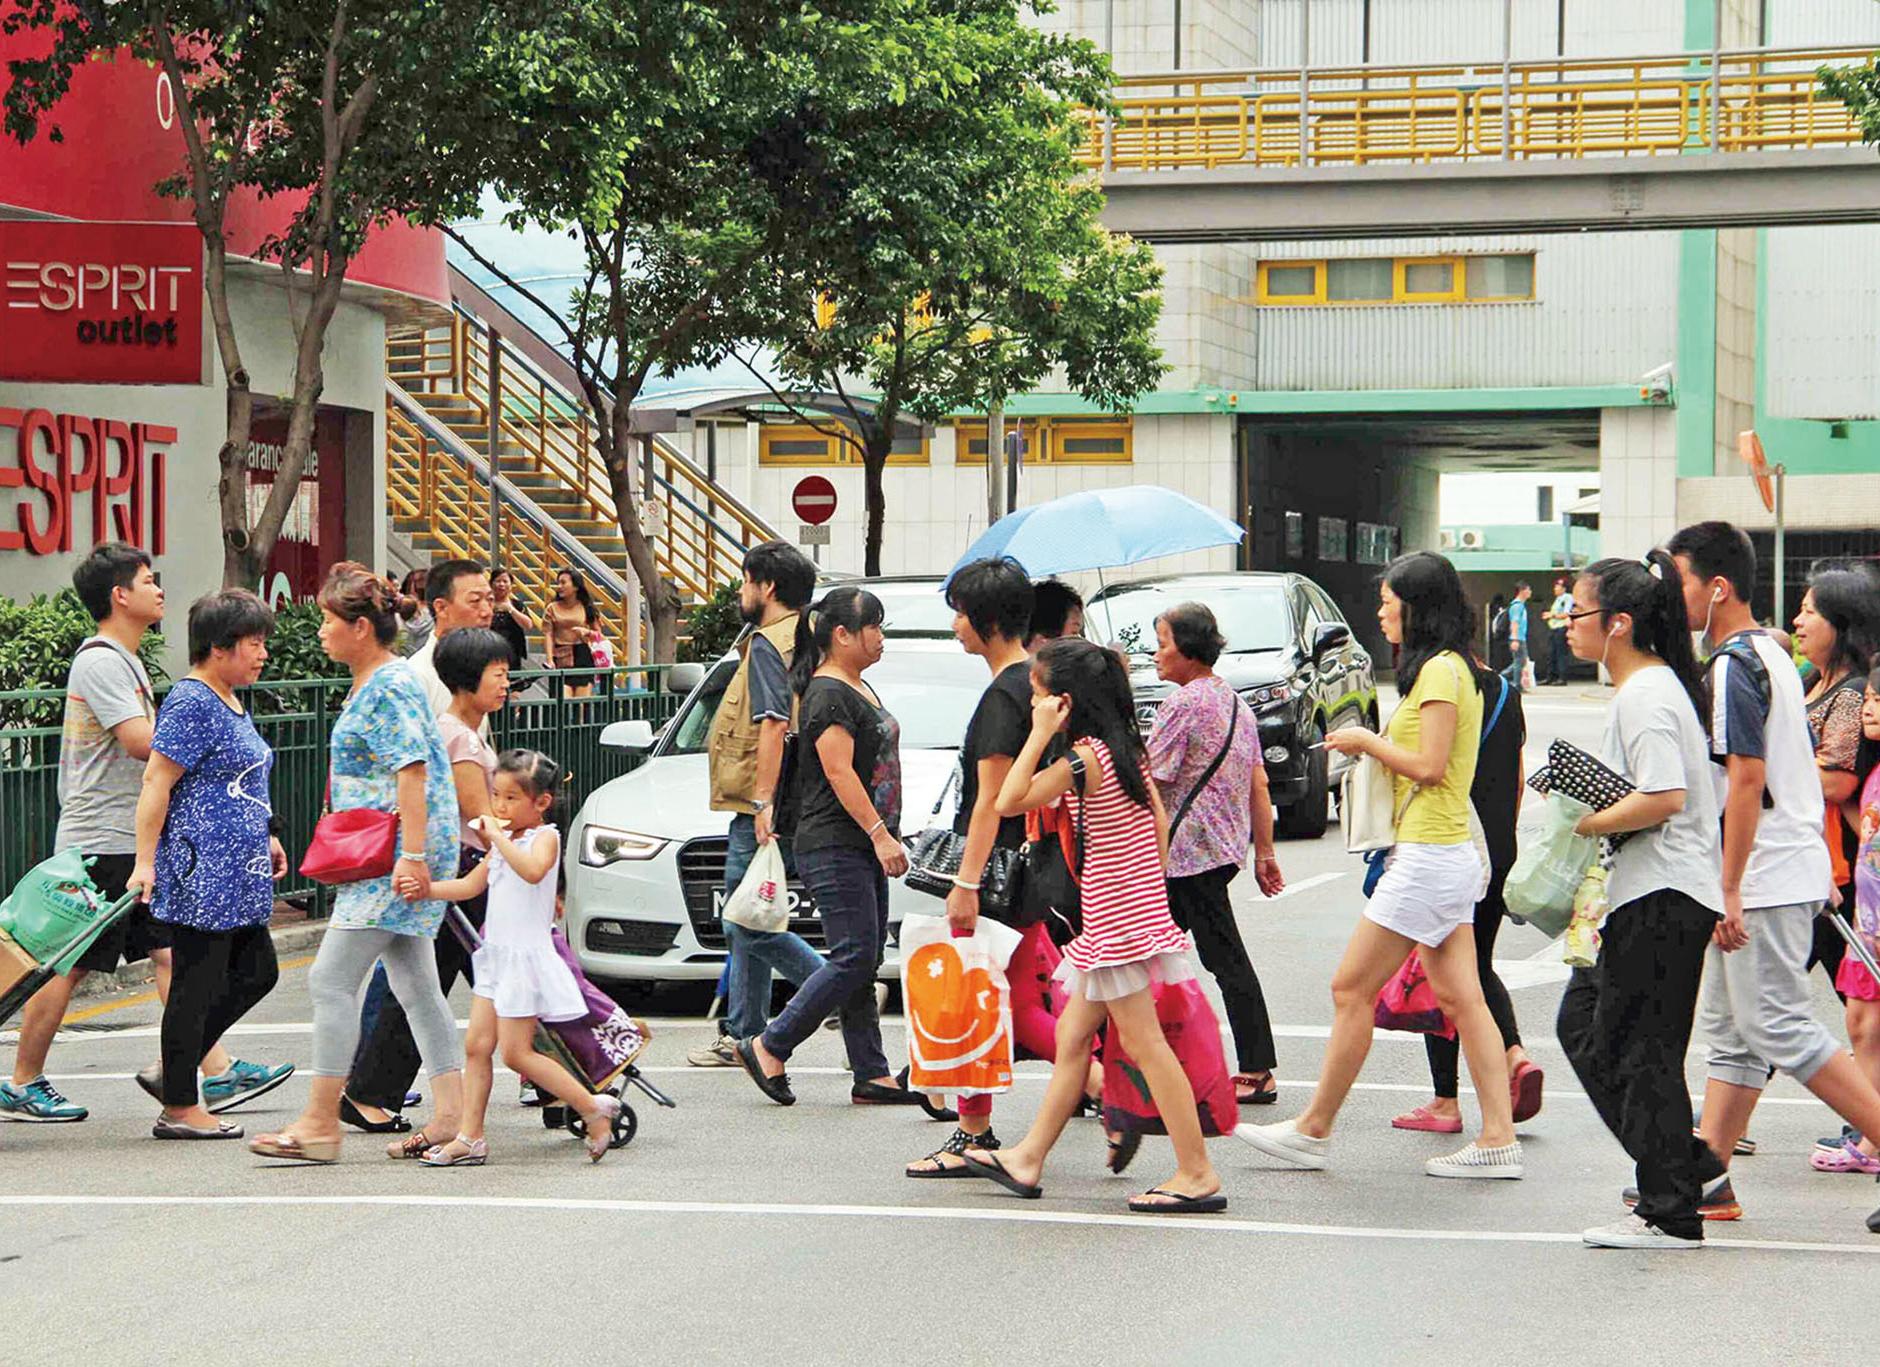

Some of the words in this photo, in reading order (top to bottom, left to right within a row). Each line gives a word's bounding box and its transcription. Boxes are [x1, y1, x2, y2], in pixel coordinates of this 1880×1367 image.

[7, 261, 192, 311] ESPRIT
[77, 315, 178, 345] outlet
[0, 407, 178, 556] ESPRIT
